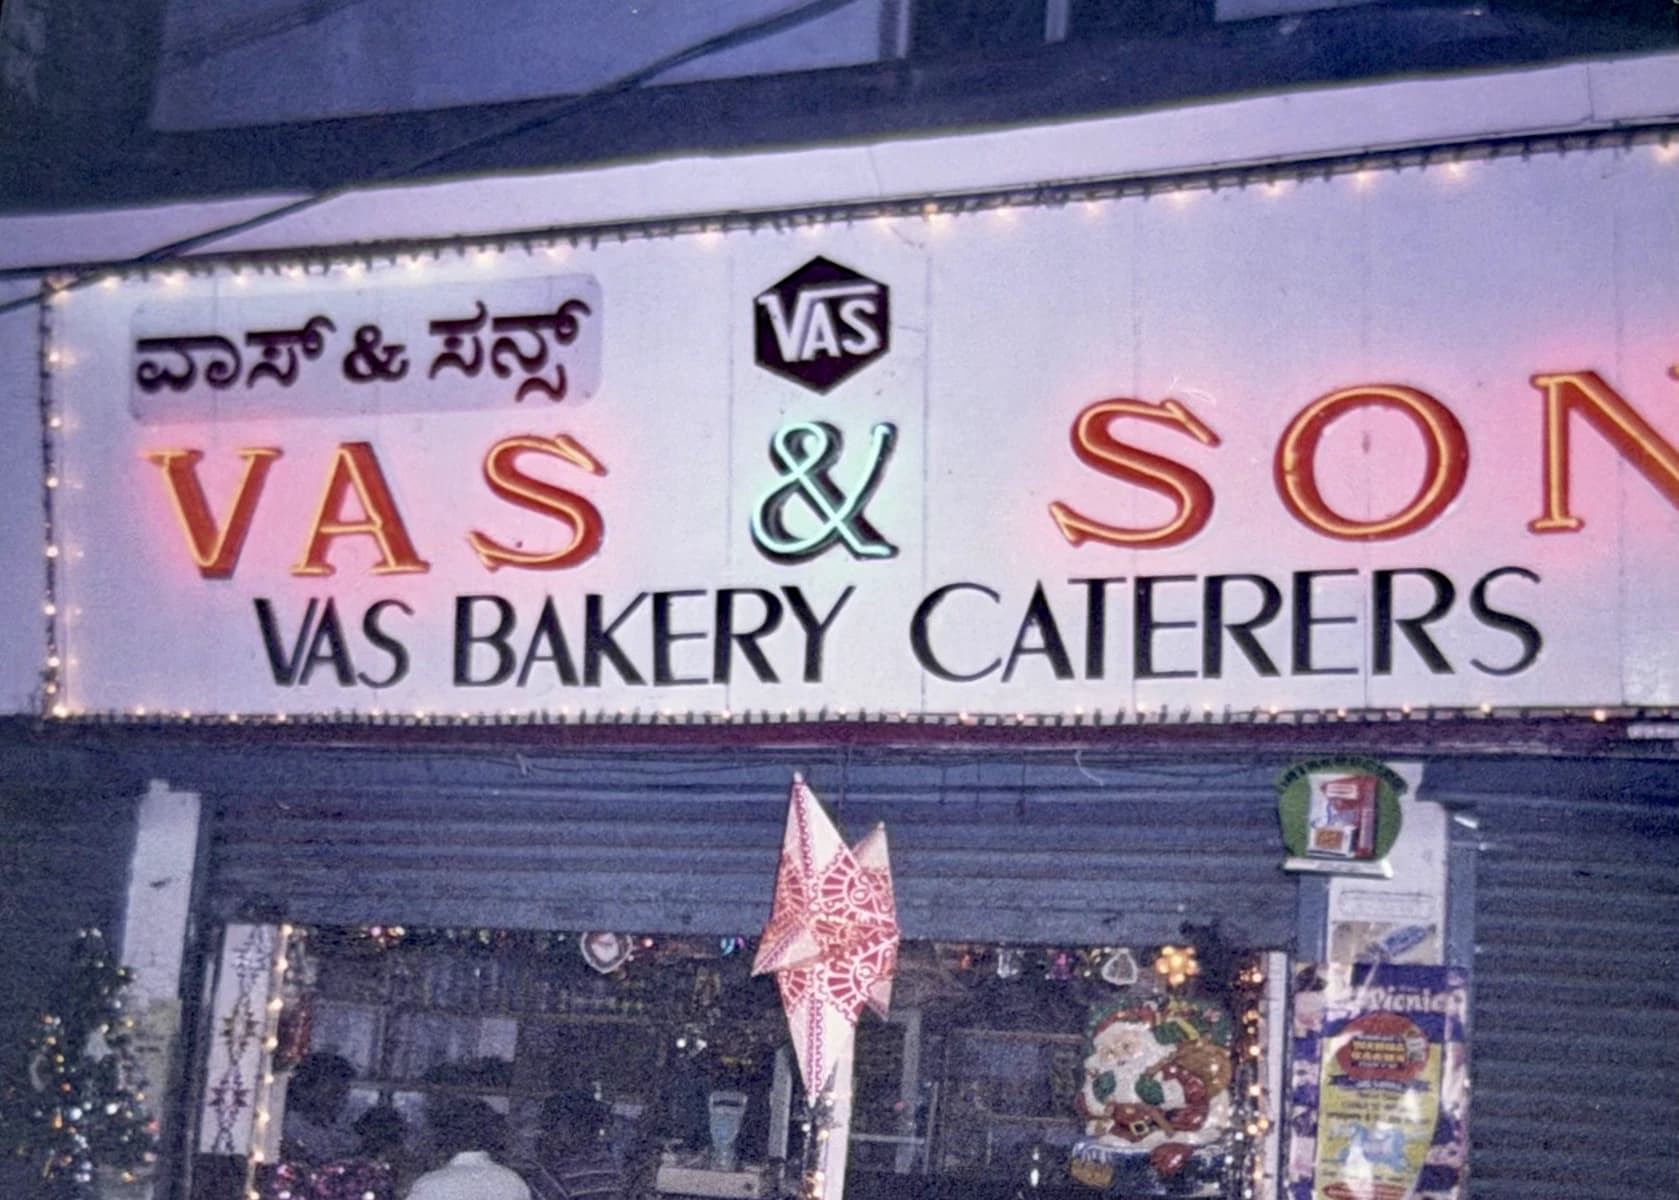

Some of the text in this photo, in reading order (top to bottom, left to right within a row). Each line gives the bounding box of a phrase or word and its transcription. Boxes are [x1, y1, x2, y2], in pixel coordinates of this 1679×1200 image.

[135, 315, 337, 393] ವಾಸ್
[342, 324, 410, 383] &
[757, 284, 881, 363] VAS
[143, 433, 607, 579] VAS
[749, 419, 900, 559] &
[252, 566, 1543, 689] VAS BAKERY CATERERS
